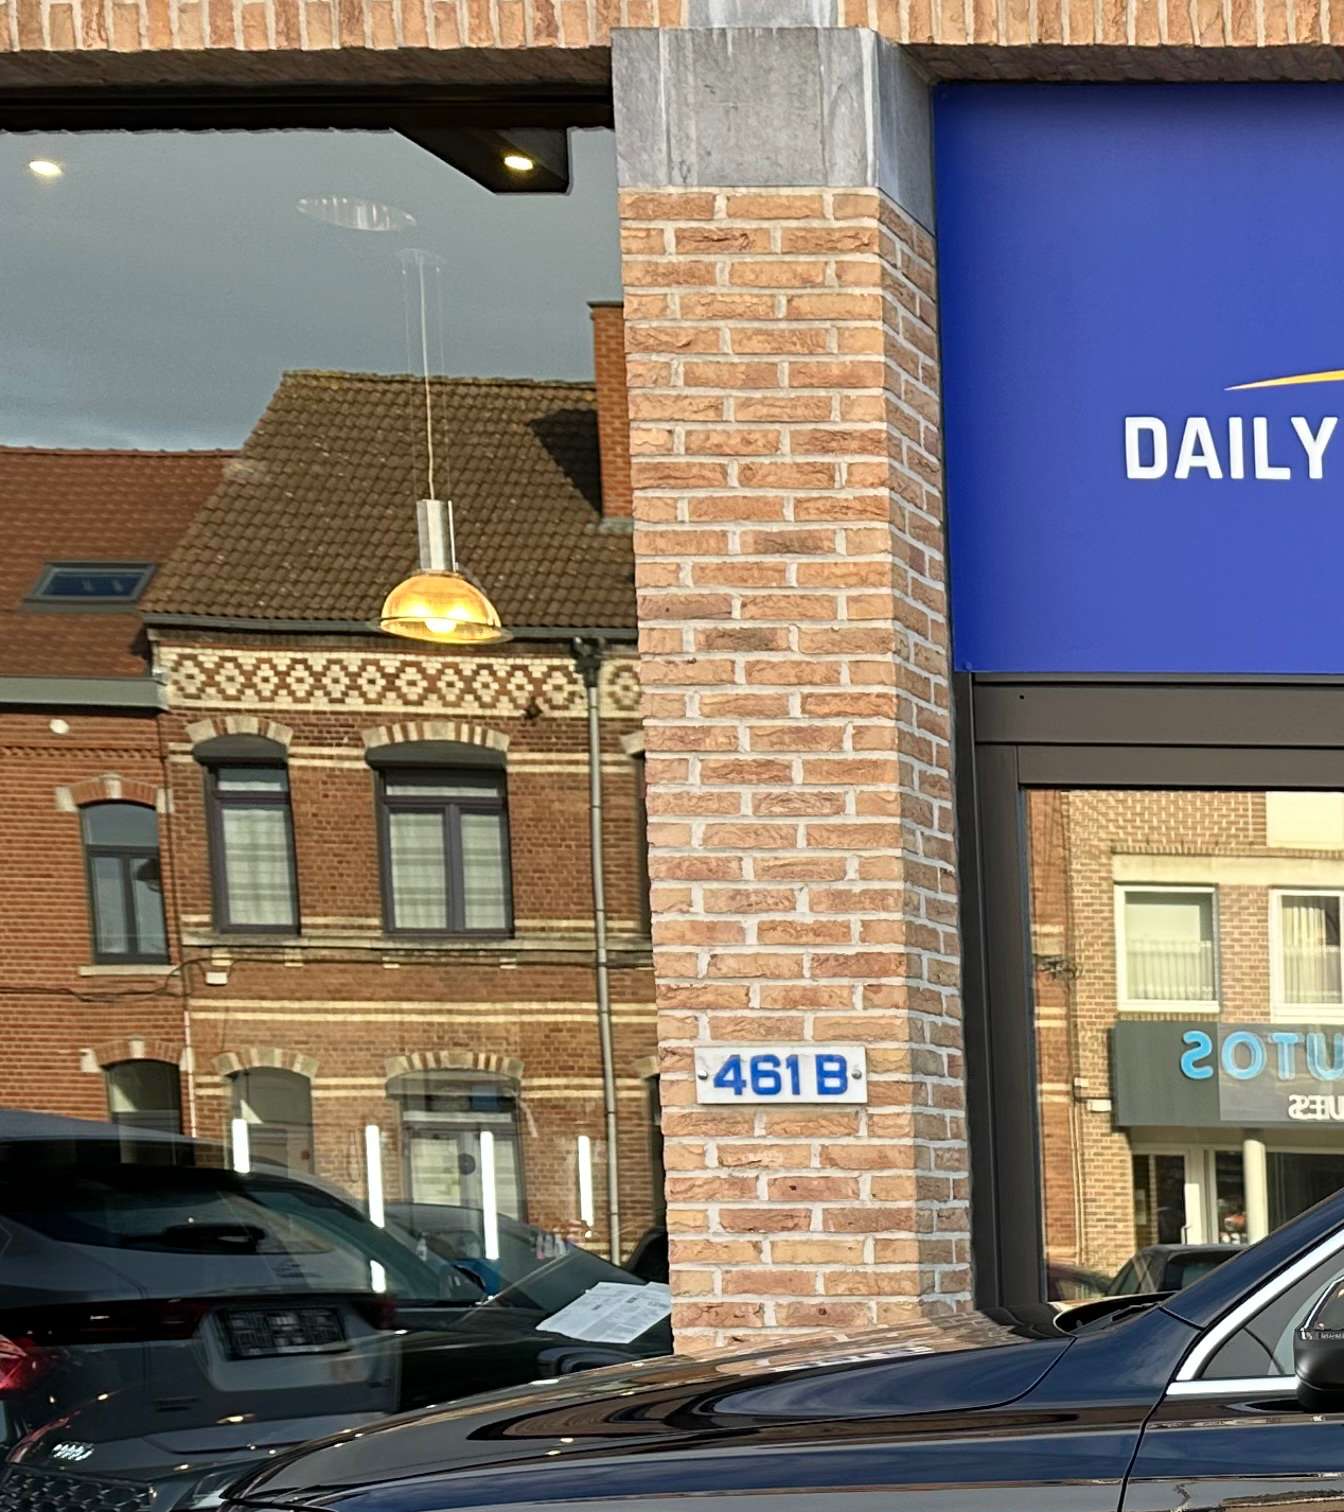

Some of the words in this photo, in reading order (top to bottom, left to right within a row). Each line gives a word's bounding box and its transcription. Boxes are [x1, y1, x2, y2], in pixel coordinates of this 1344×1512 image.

[1124, 415, 1338, 480] DAILY
[713, 1054, 801, 1096] 461
[815, 1054, 848, 1095] B
